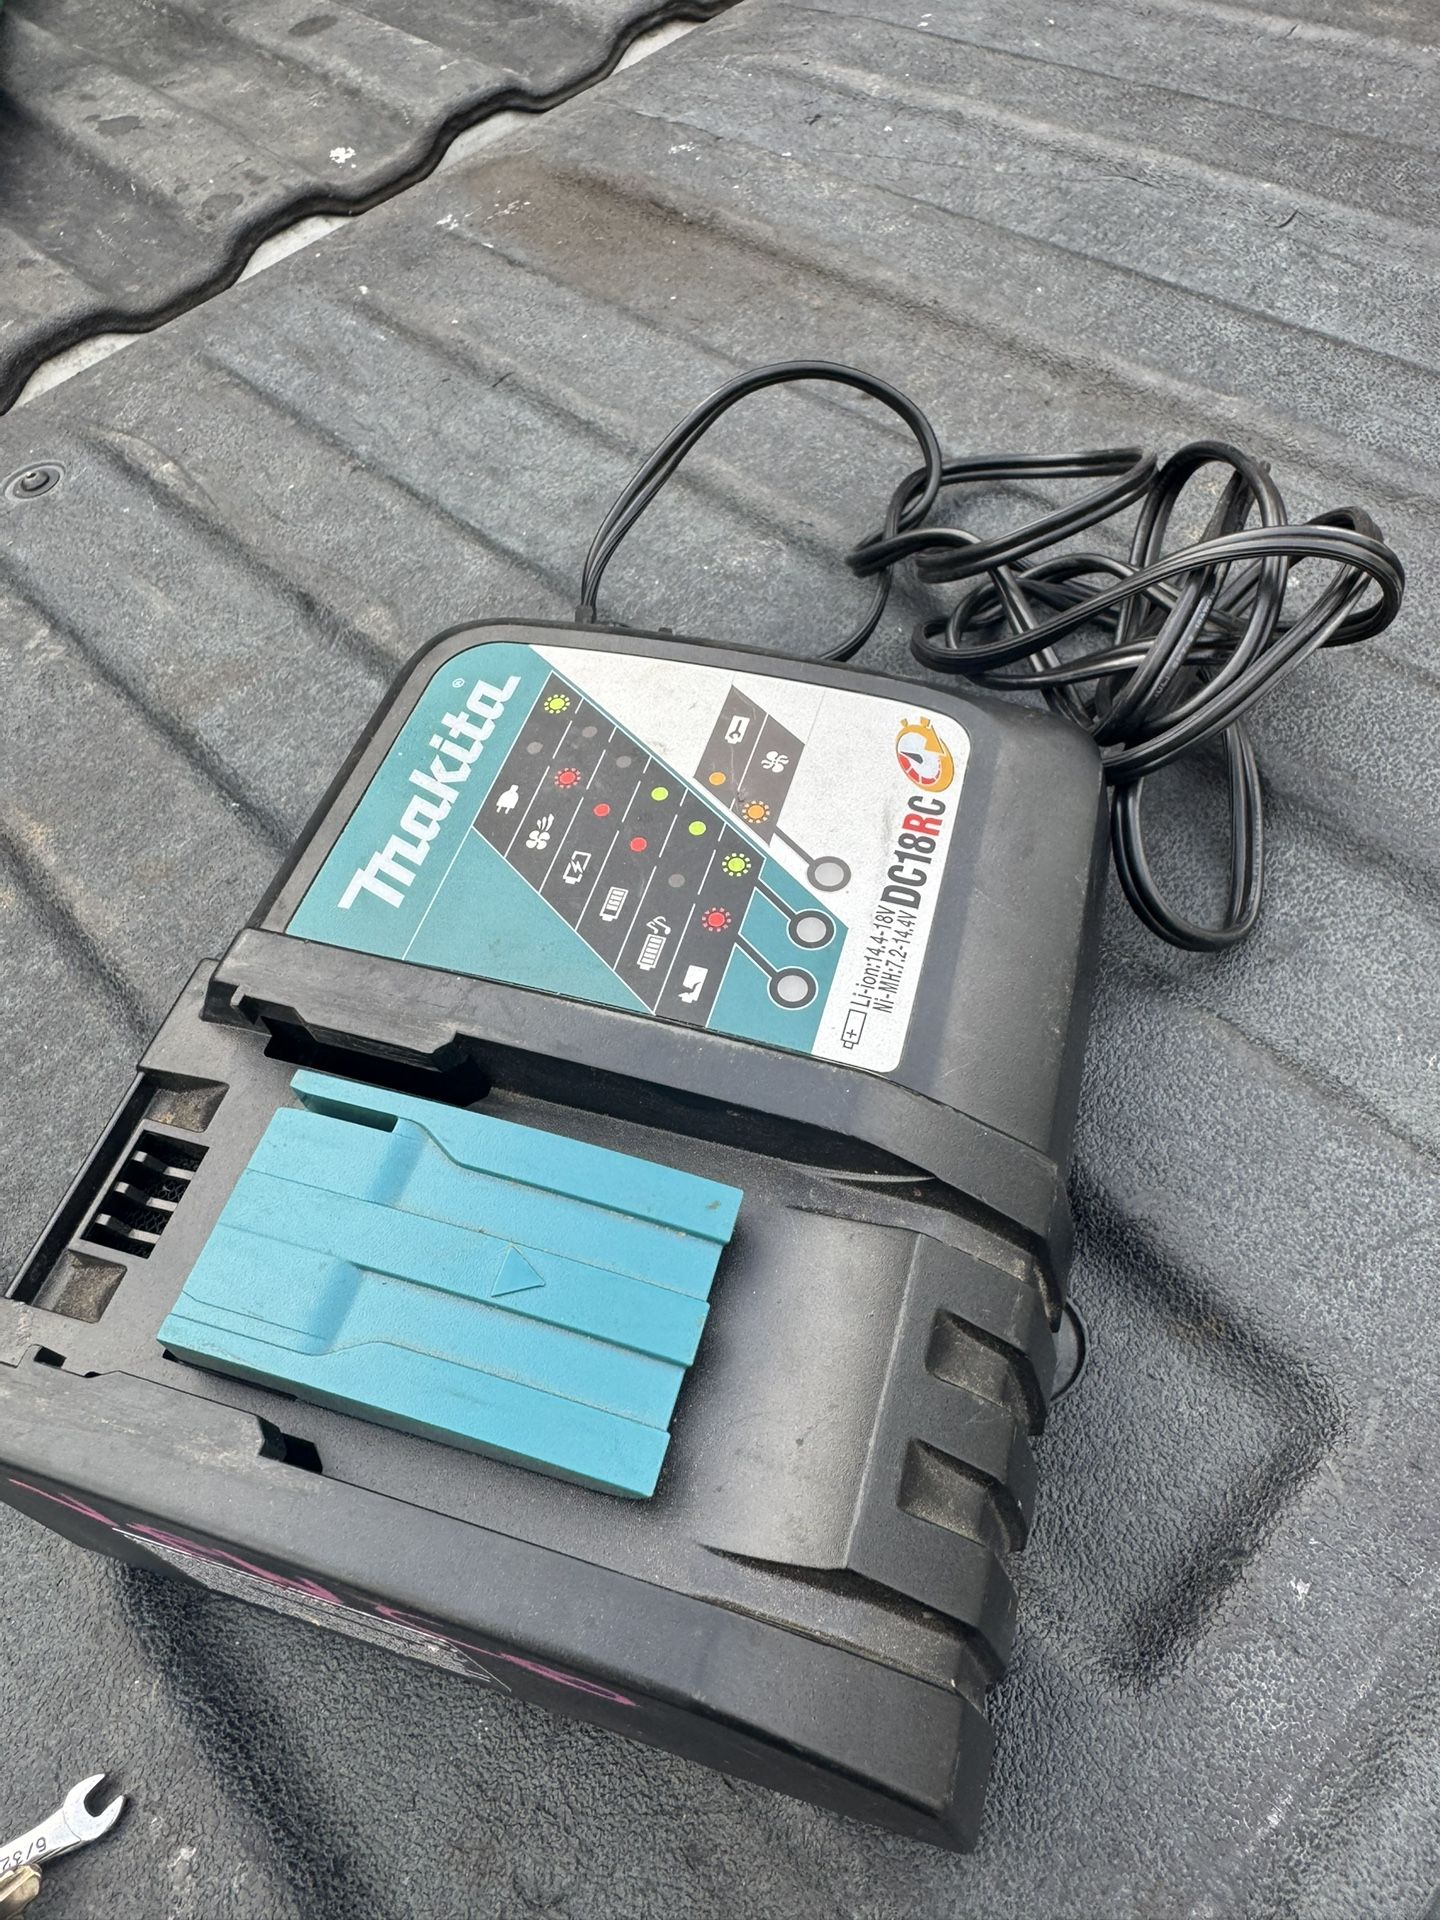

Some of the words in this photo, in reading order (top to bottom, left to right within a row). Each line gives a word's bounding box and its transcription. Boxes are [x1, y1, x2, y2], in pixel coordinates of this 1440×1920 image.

[337, 676, 521, 909] makita
[881, 795, 946, 910] DC18RC
[850, 904, 896, 1008] Li-ion:14.4-18V
[872, 911, 917, 1014] Ni-MH:7.2-14.4V
